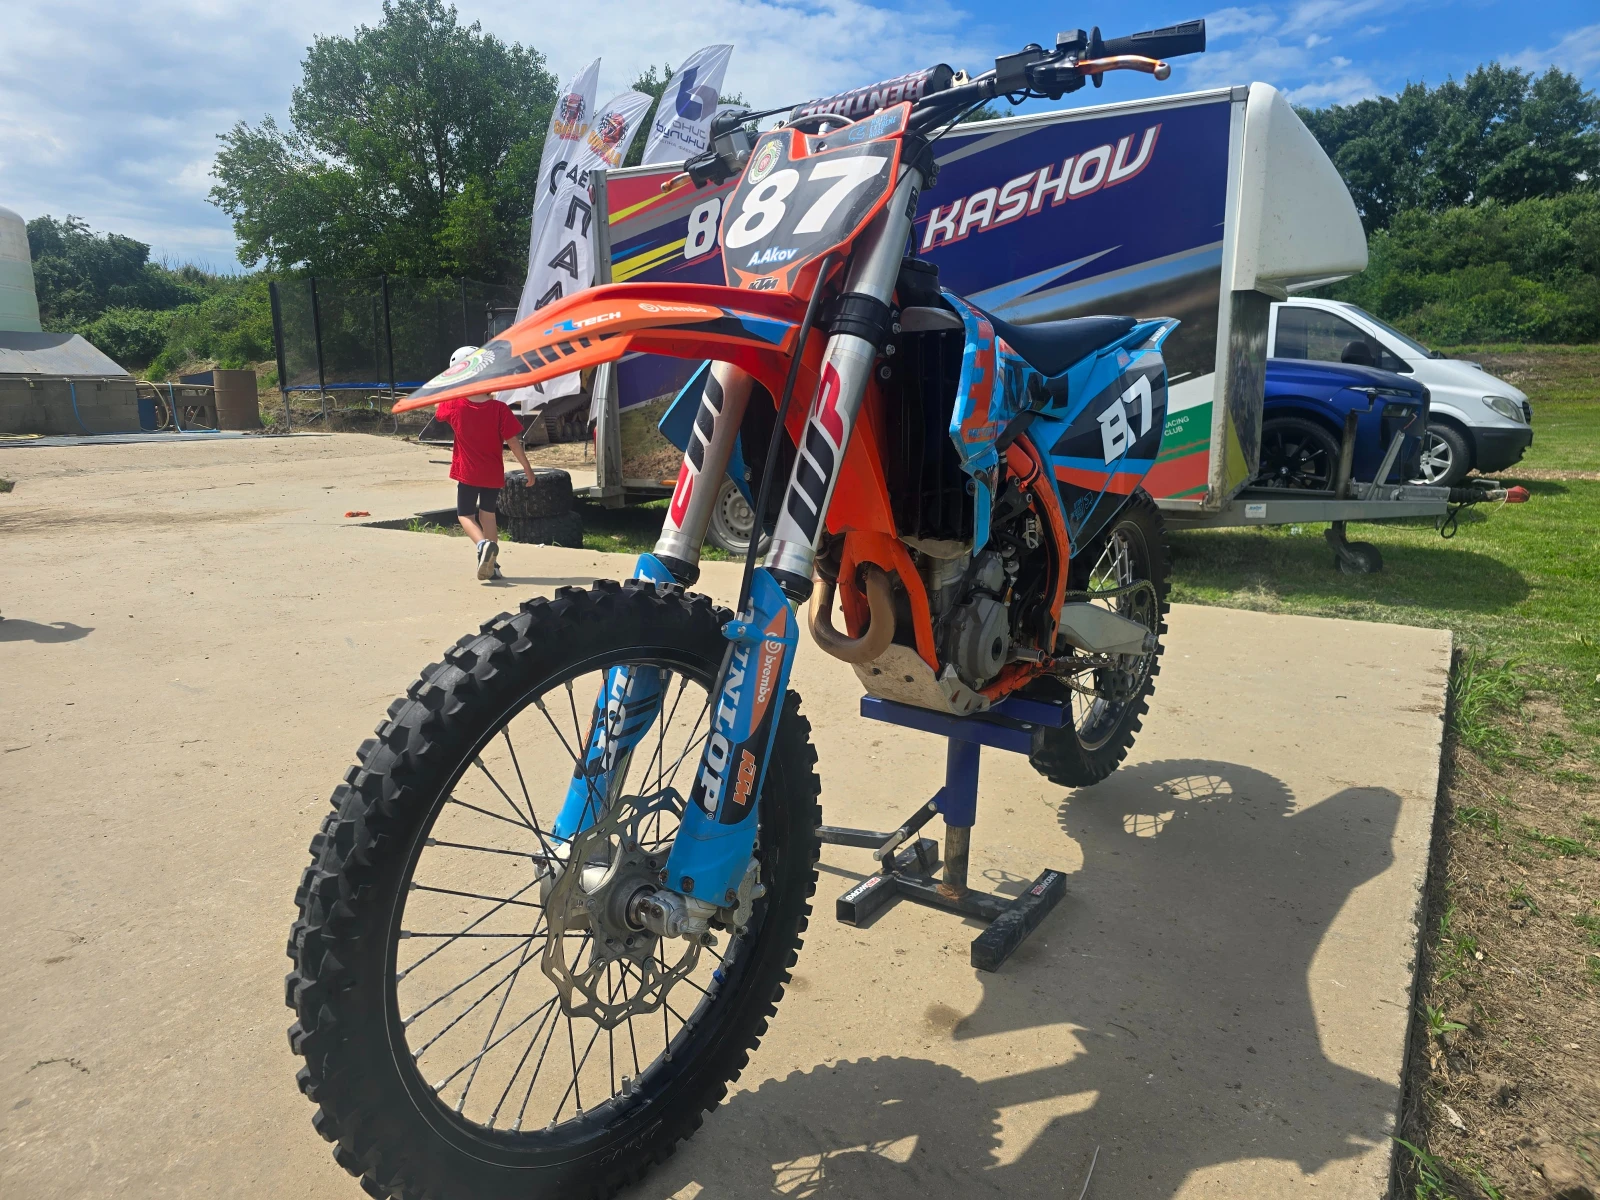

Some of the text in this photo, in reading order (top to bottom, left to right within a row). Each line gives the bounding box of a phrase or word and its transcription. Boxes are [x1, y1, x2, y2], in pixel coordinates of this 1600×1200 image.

[684, 190, 735, 260] 8
[726, 156, 889, 249] 87
[747, 246, 799, 267] A.Akov
[1096, 373, 1153, 466] 87
[1164, 425, 1184, 437] CLUB
[757, 654, 776, 702] brembo
[733, 748, 757, 805] KTM
